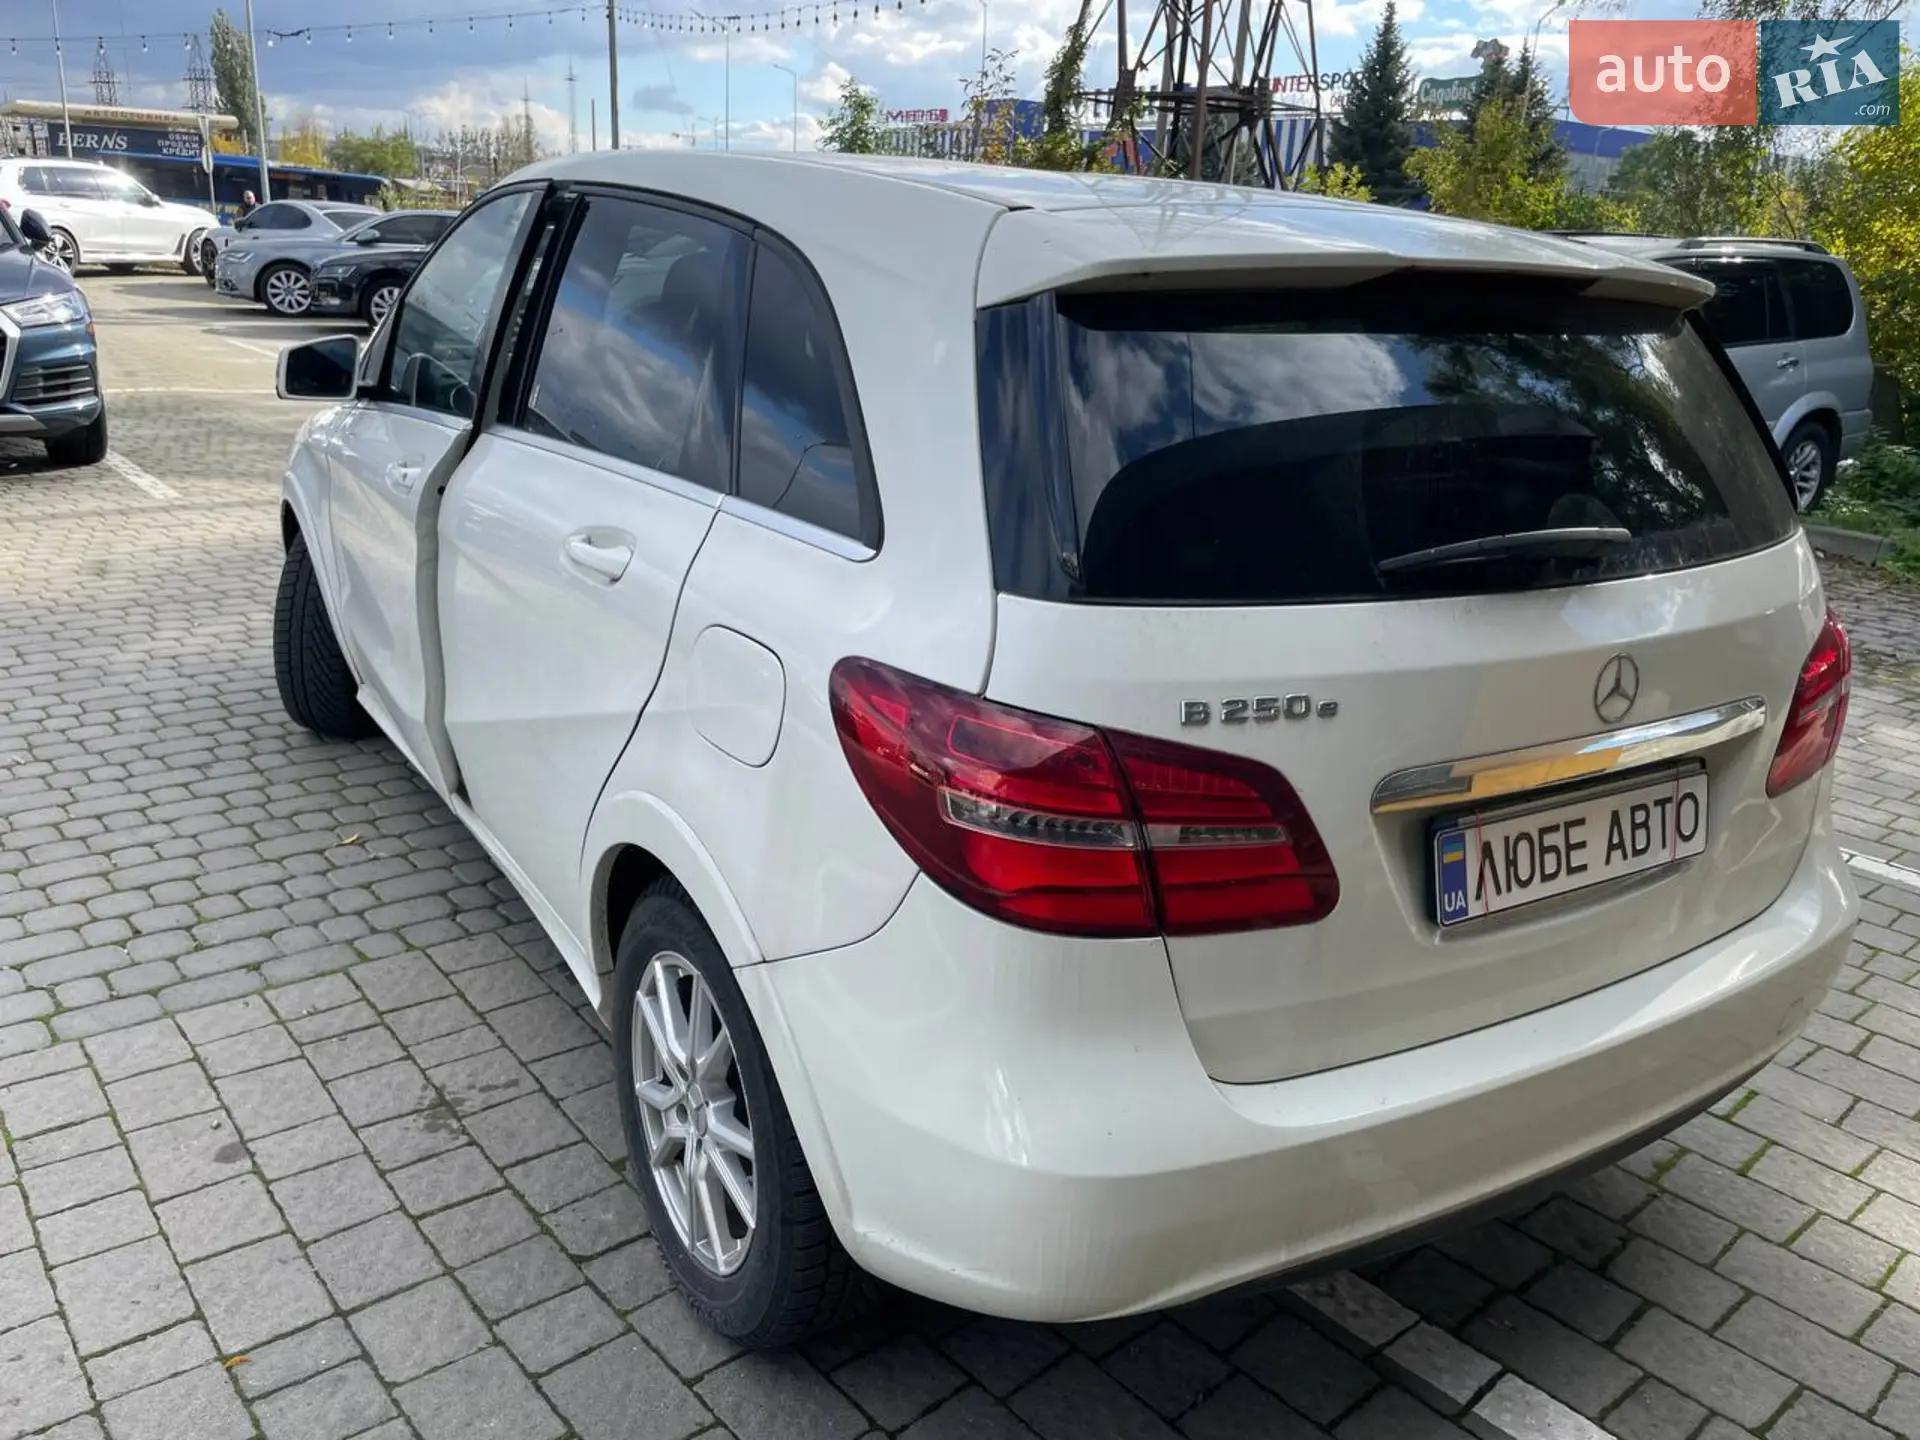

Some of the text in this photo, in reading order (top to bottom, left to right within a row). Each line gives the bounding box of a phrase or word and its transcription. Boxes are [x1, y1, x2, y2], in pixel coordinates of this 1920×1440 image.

[57, 131, 128, 150] BERNS
[1181, 699, 1211, 726] B
[1475, 791, 1699, 902] ЛЮБЕ АВТО
[1444, 890, 1466, 912] UA
